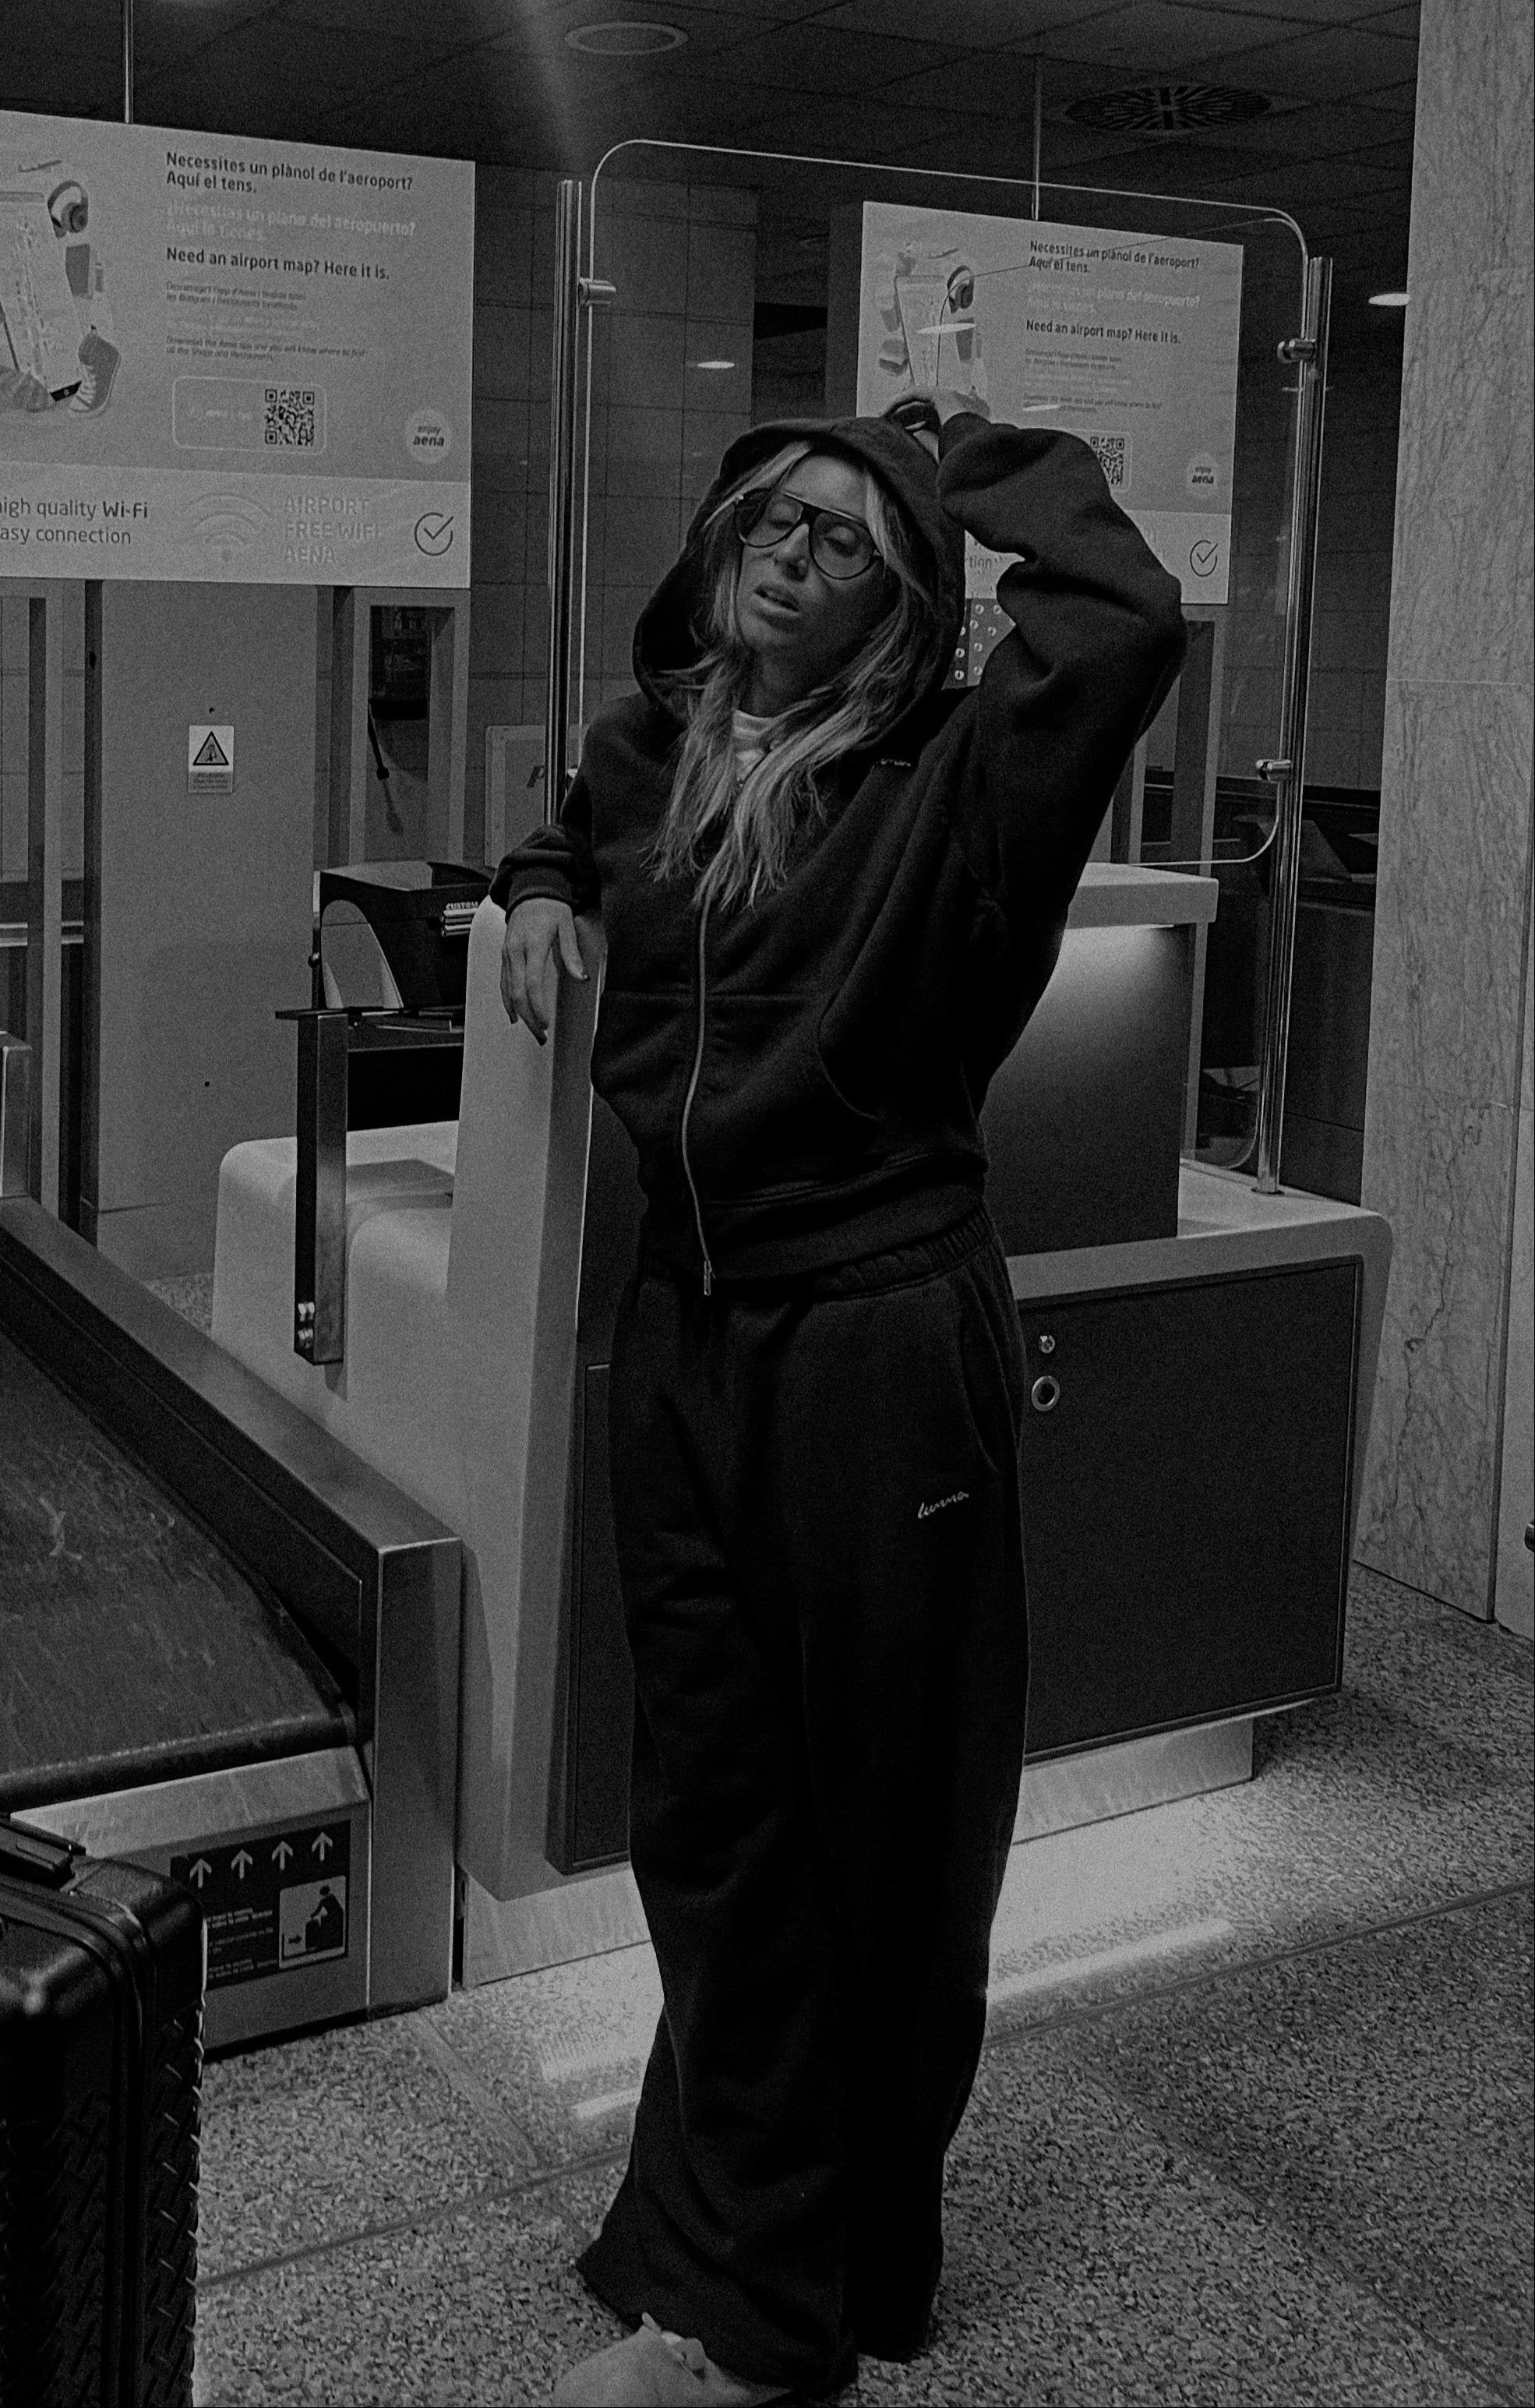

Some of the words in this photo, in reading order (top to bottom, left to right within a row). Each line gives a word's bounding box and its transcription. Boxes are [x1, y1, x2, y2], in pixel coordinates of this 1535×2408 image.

[166, 151, 245, 173] Necessites
[249, 163, 267, 175] un
[273, 163, 315, 180] plànol
[319, 168, 336, 182] de
[340, 170, 413, 190] l'aeroport?
[166, 170, 199, 189] Aquí
[204, 175, 217, 189] el
[221, 178, 256, 193] tens.
[1030, 241, 1085, 257] Necessites
[1087, 249, 1099, 258] un
[1134, 252, 1146, 263] de
[166, 247, 205, 263] Need
[209, 253, 227, 266] an
[231, 252, 279, 271] airport
[283, 260, 319, 276] map?
[324, 261, 357, 278] Here
[361, 263, 371, 278] it
[375, 264, 390, 280] is.
[1054, 259, 1064, 270] el
[1026, 320, 1053, 333] Need
[1055, 323, 1067, 334] an
[1070, 323, 1104, 338] airport
[1106, 327, 1132, 341] map?
[1134, 329, 1158, 342] Here
[1161, 331, 1168, 343] it
[413, 436, 444, 447] aena
[0, 496, 30, 518] igh
[37, 500, 97, 521] quality
[103, 500, 148, 518] Wi-Fi
[284, 495, 370, 515] AIRPORT
[37, 527, 131, 544] connection
[284, 520, 333, 538] FREE
[284, 545, 337, 564] AENA
[966, 554, 992, 569] tion
